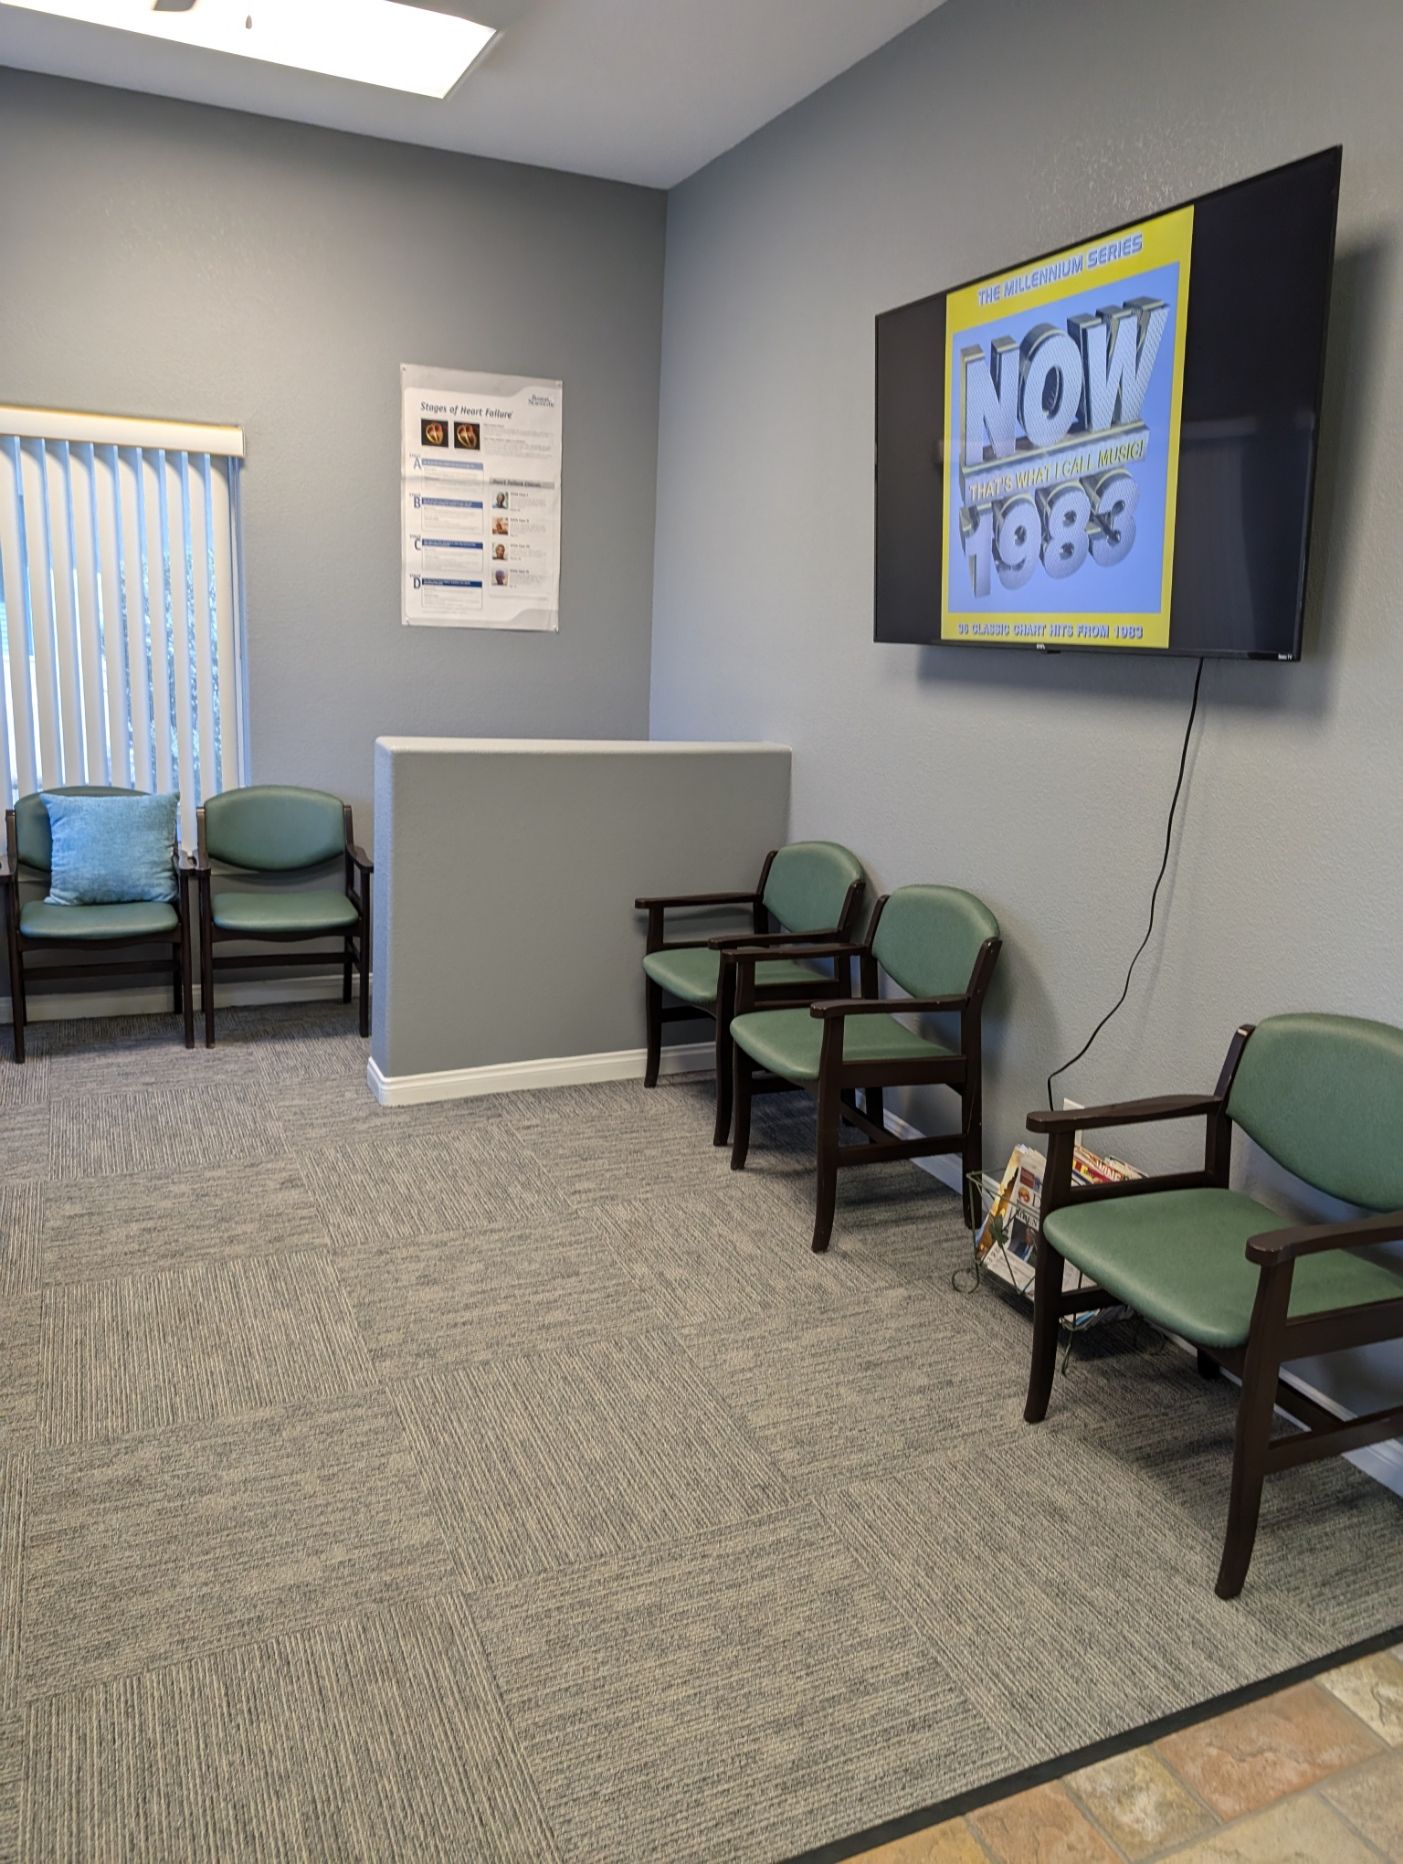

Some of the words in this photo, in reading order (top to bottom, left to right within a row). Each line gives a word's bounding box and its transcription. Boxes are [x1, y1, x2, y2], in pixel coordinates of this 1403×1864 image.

[978, 284, 1001, 306] THE
[1003, 254, 1084, 298] MILLENNIUM
[1086, 231, 1143, 269] SERIES
[420, 401, 447, 414] Stages
[450, 405, 458, 416] of
[460, 405, 482, 417] Heart
[485, 407, 513, 419] Failure
[960, 297, 1170, 466] NOW
[969, 477, 1012, 501] THAT'S
[1015, 467, 1050, 489] WHAT
[1055, 463, 1059, 480] I
[1062, 453, 1092, 477] CALL
[1097, 438, 1145, 470] MUSIC!
[959, 468, 1141, 598] 1983
[413, 576, 421, 589] D
[972, 623, 1010, 637] CLASSIC
[1013, 623, 1047, 638] CHART
[1049, 624, 1074, 639] HITS
[1077, 624, 1110, 640] FROM
[1115, 625, 1144, 640] 1983
